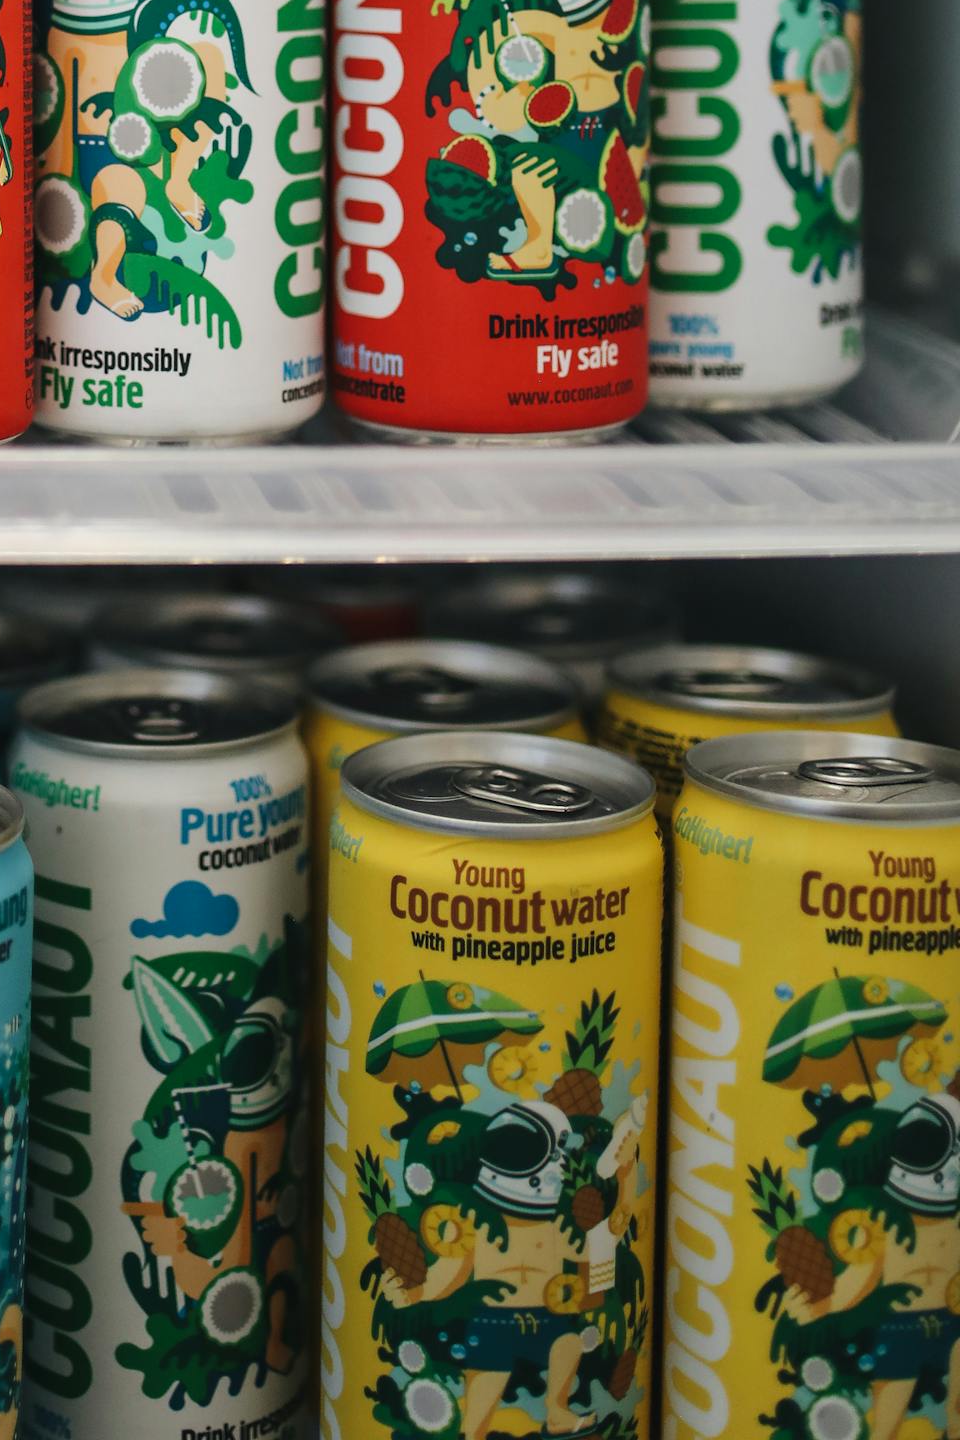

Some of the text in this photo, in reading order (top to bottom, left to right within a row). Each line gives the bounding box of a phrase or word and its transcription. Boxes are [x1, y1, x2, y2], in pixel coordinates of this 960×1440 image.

[489, 313, 549, 339] Drink
[60, 341, 191, 376] irresponsibly
[283, 359, 304, 382] Not
[358, 343, 404, 379] from
[537, 344, 572, 378] Fly
[577, 339, 618, 371] safe
[41, 366, 143, 409] Fly safe
[508, 378, 634, 406] www.coconaut.com
[230, 774, 272, 802] 100%
[181, 807, 254, 845] Pure
[675, 807, 754, 864] GoHigher!
[199, 837, 271, 871] coconut
[869, 850, 936, 883] Young
[452, 859, 525, 893] Young
[390, 875, 630, 933] Coconut water
[800, 871, 952, 924] Coconut
[411, 930, 616, 965] with pineapple juice
[826, 927, 862, 947] with
